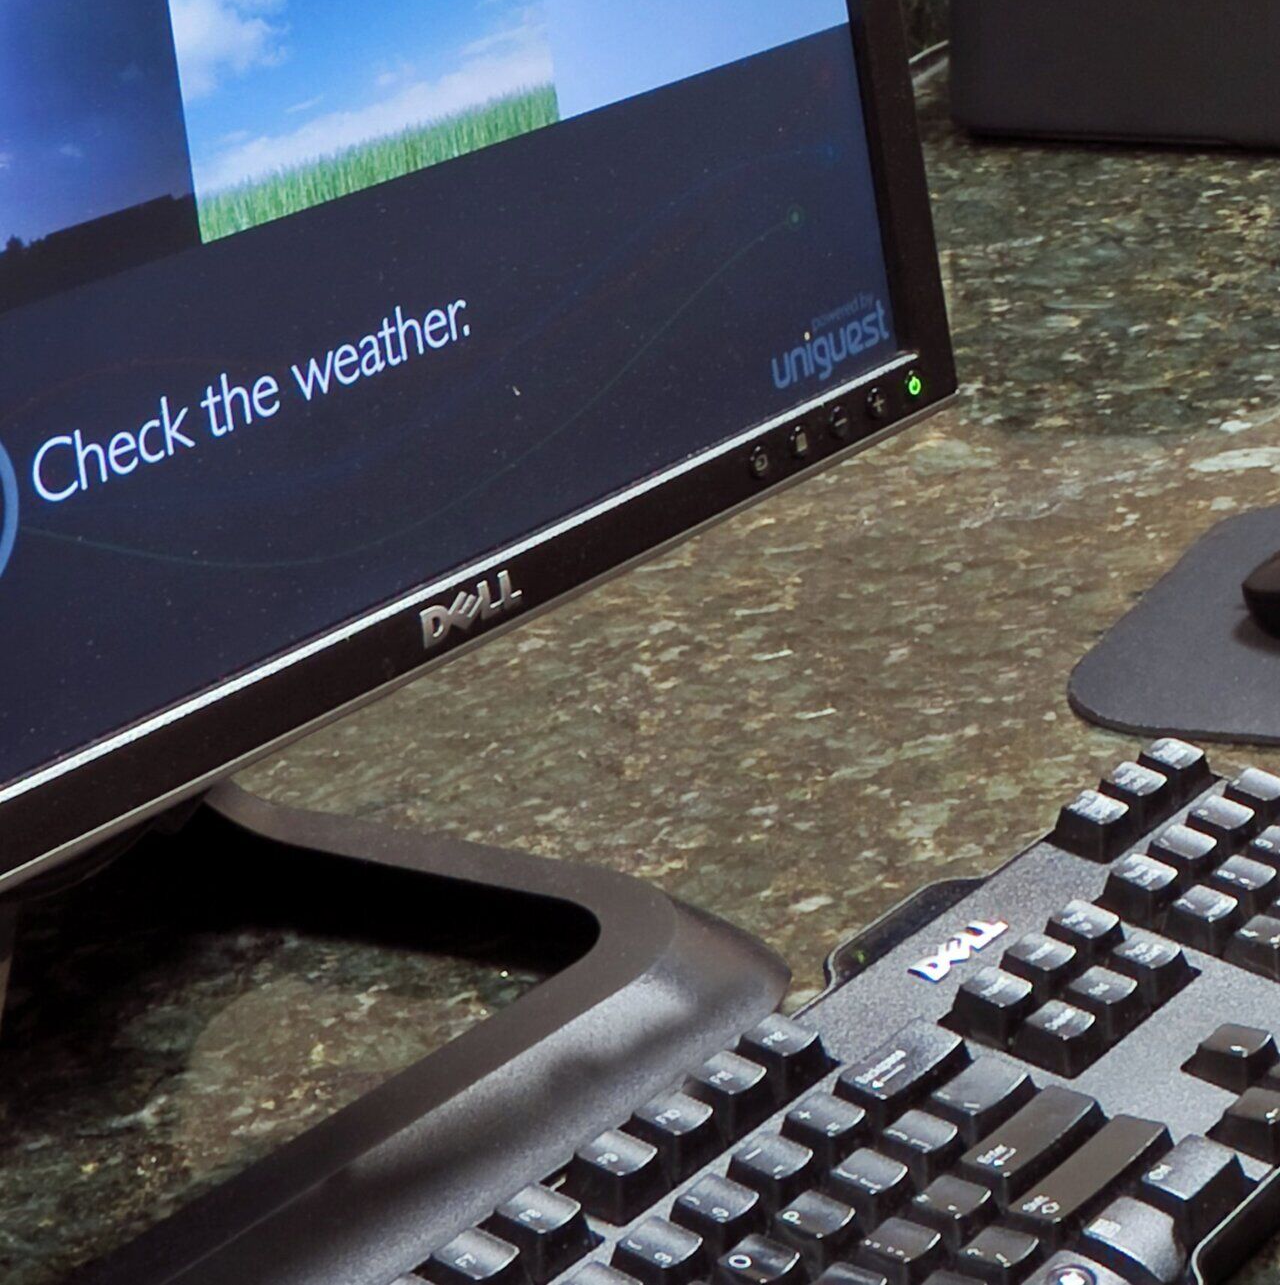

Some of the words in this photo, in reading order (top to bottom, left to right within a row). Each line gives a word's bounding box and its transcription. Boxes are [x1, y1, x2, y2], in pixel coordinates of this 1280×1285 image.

[771, 299, 890, 389] uniguest
[32, 396, 196, 502] Check
[200, 373, 281, 437] the
[290, 298, 470, 401] weather.
[419, 569, 522, 650] DELL
[907, 919, 1009, 984] DELL
